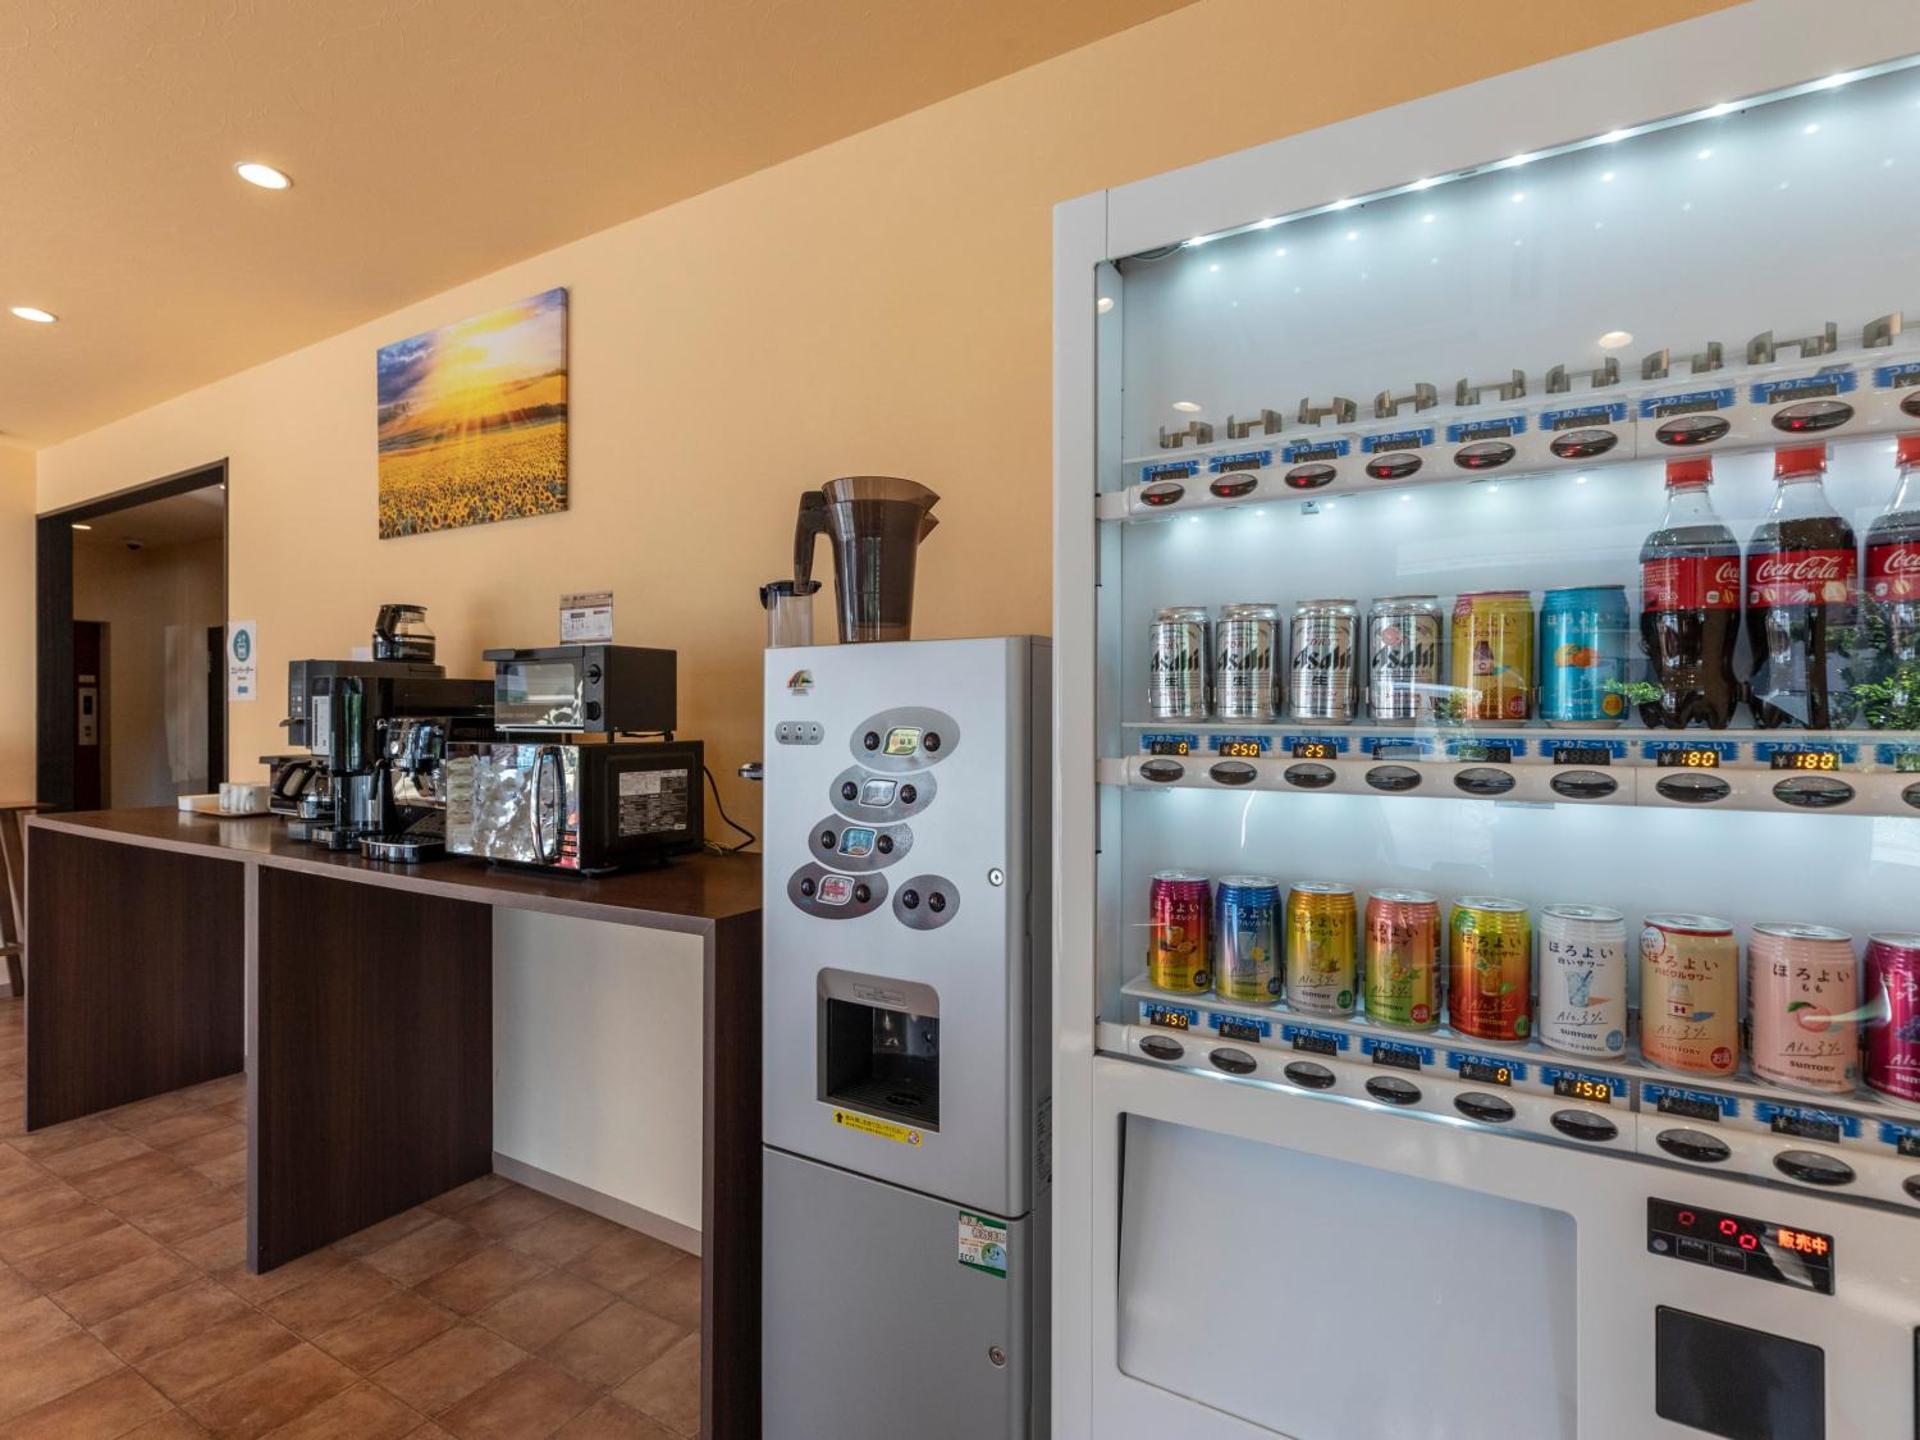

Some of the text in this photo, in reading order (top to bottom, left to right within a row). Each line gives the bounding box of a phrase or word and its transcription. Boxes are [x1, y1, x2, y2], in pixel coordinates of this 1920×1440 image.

[1151, 648, 1199, 672] Asahi
[1218, 648, 1270, 671] Asahi
[1293, 645, 1351, 670] Asahi
[1372, 643, 1434, 669] Asahi
[1549, 941, 1614, 959] ほろよい
[1557, 957, 1605, 968] 白いサワー
[1648, 950, 1718, 971] ほろよい
[1655, 968, 1713, 981] ハピクルサワー
[1773, 963, 1850, 983] ほろよい
[1802, 984, 1823, 993] もも
[1289, 1026, 1343, 1041] つめた～い
[1560, 1029, 1598, 1040] SUNTORY
[1370, 1039, 1429, 1055] つめた～い
[1661, 1042, 1702, 1056] SUNTORY
[1456, 1053, 1519, 1070] つめた～い
[1790, 1060, 1835, 1072] SUNTORY
[1550, 1069, 1619, 1087] つめた～い
[1576, 1083, 1607, 1098] 150
[1653, 1086, 1728, 1106] つめた～い
[1777, 1228, 1829, 1256] 販売中
